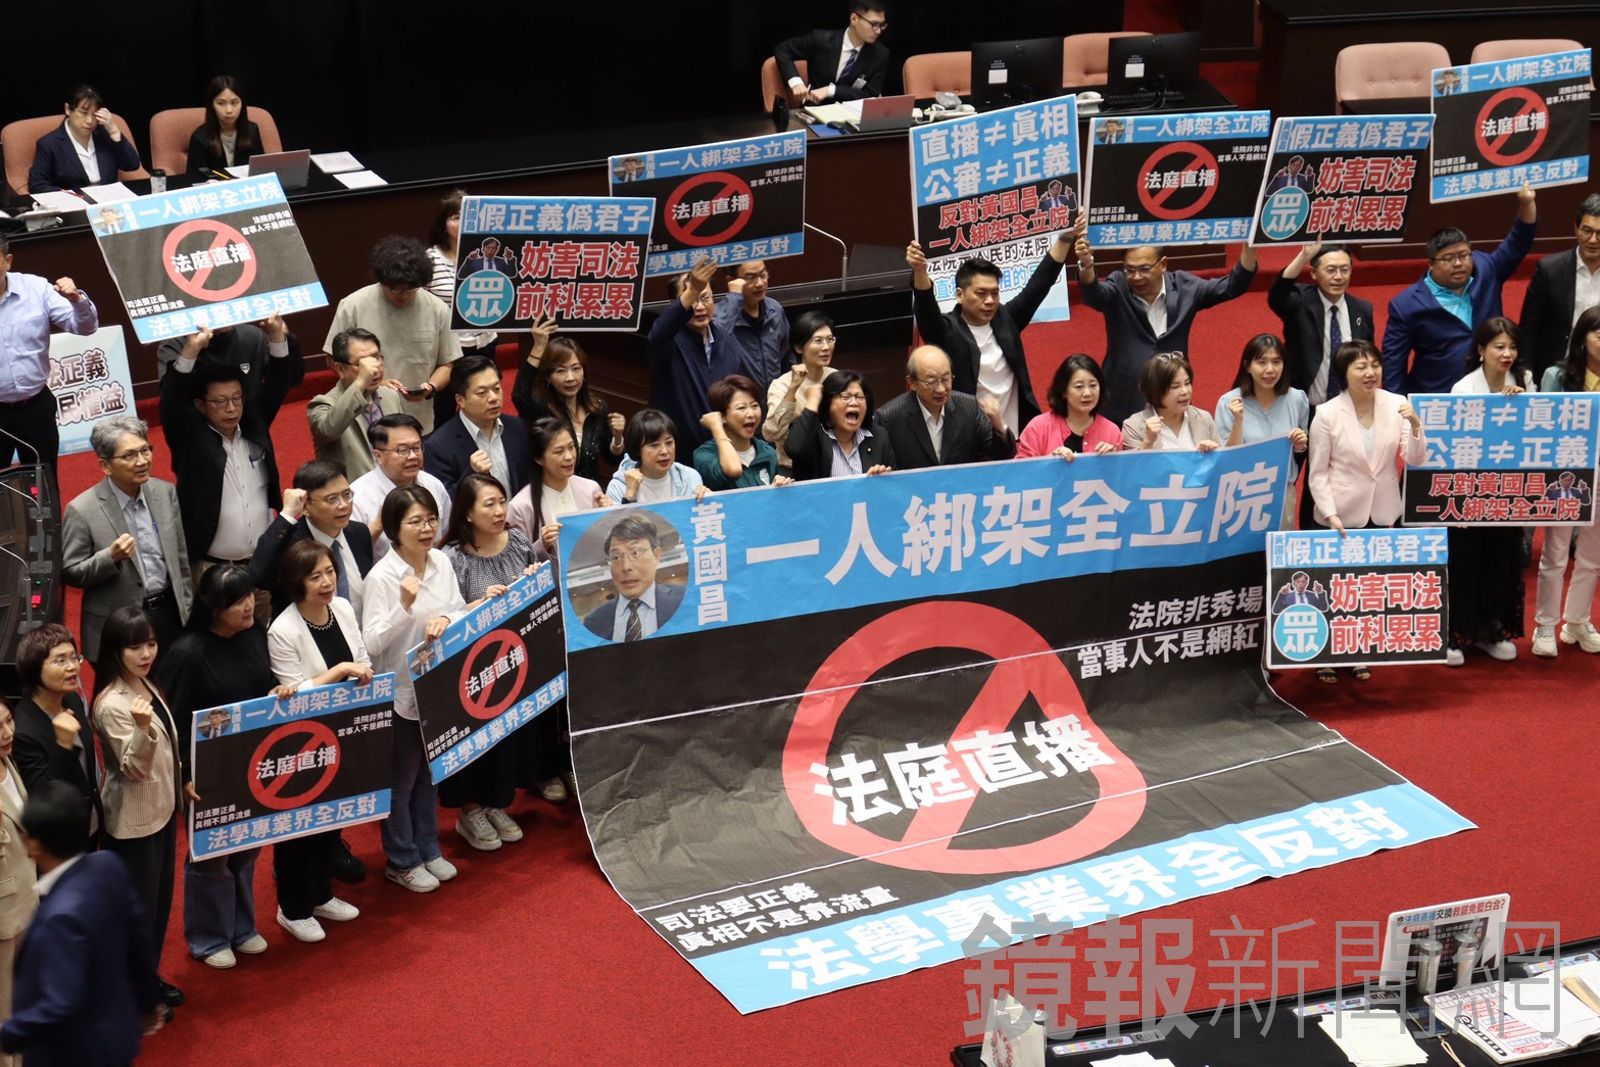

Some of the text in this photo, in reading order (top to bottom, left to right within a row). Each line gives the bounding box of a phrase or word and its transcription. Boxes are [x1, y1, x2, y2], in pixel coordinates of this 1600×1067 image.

[1472, 54, 1590, 84] 一人綁架全立院
[1138, 115, 1269, 136] 一人綁架全立院
[1481, 112, 1546, 137] 法庭直播
[660, 138, 803, 169] 一人綁架全立院
[923, 142, 1070, 202] 公審≠正義
[1144, 169, 1216, 189] 法庭直播
[1315, 156, 1417, 194] 妨害司法
[1444, 159, 1579, 195] 法學專業界全反對
[140, 181, 282, 218] 一人綁架全立院
[671, 194, 750, 220] 法庭直播
[939, 186, 1039, 230] 反對黃國昌
[1306, 195, 1407, 233] 前科累累
[929, 206, 1069, 252] 一人綁架全立院
[1100, 219, 1249, 244] 法學專業界全反對
[171, 243, 252, 274] 法庭直播
[519, 241, 640, 279] 妨害司法
[515, 282, 634, 320] 前科累累
[1429, 473, 1547, 497] 反對黃國昌
[746, 460, 1279, 586] 一人綁架全立院
[1416, 498, 1581, 521] 一人綁架全立院
[691, 501, 728, 626] 黃國昌
[445, 567, 553, 646] 一人綁架全立院
[1129, 585, 1264, 631] 法院非秀場
[1330, 571, 1442, 612] 妨害司法
[1077, 622, 1260, 680] 當事人不是網紅
[1330, 614, 1442, 655] 前科累累
[464, 645, 526, 698] 法庭直播
[246, 678, 392, 720] 一人綁架全立院
[338, 719, 392, 737] 當事人不是網紅
[442, 677, 565, 775] 法學專業界全反對
[255, 745, 337, 780] 法庭直播
[809, 714, 1116, 827] 法庭直播
[208, 794, 377, 850] 法學專業界全反對
[655, 882, 819, 932] 司法要正義
[760, 796, 1412, 993] 法學專業界全反對
